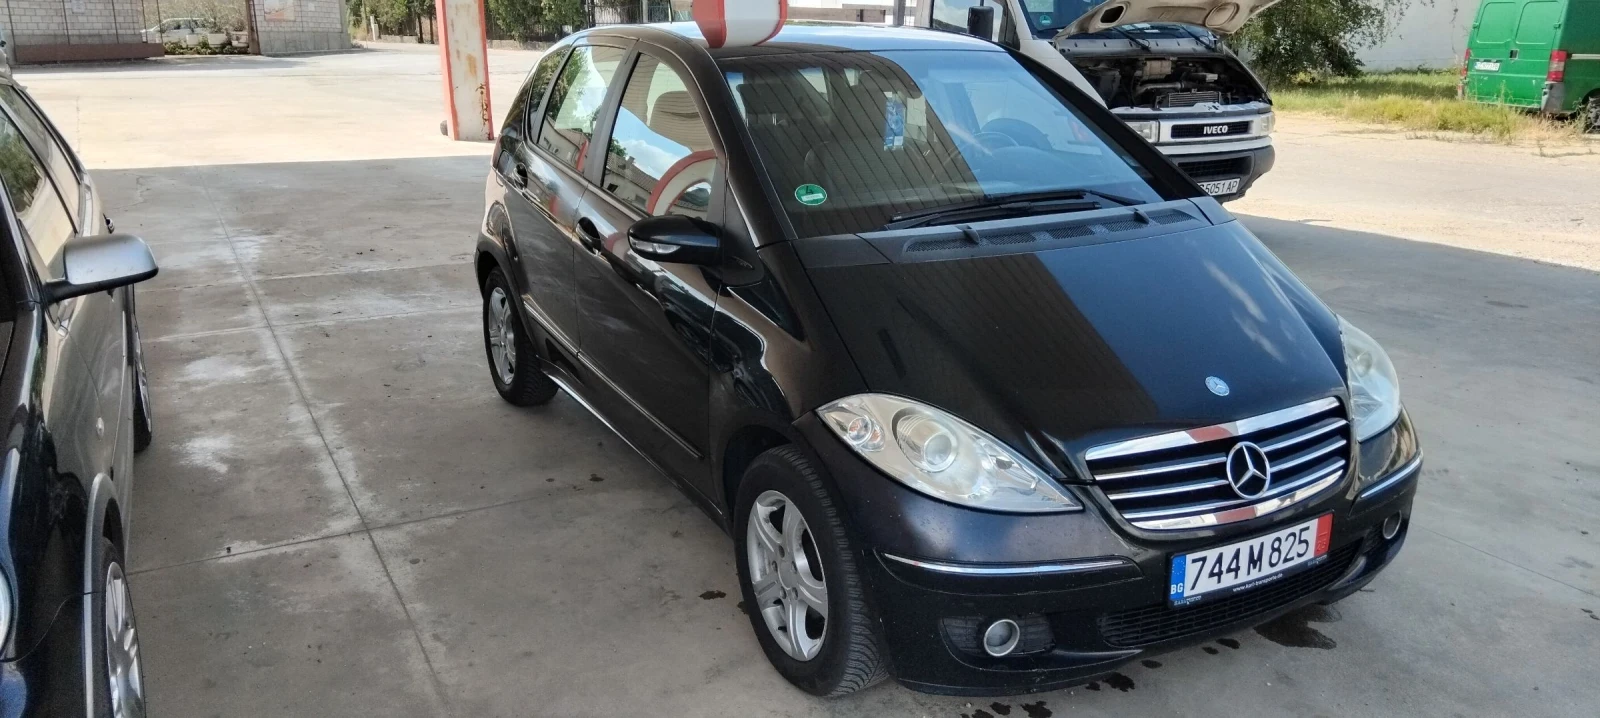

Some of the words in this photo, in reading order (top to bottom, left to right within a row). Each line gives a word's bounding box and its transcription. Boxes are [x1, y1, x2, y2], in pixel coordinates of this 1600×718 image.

[1203, 125, 1229, 135] IVECO
[1189, 547, 1242, 591] 744
[1246, 541, 1265, 577] M
[1268, 525, 1311, 568] 825
[1170, 582, 1184, 595] BG
